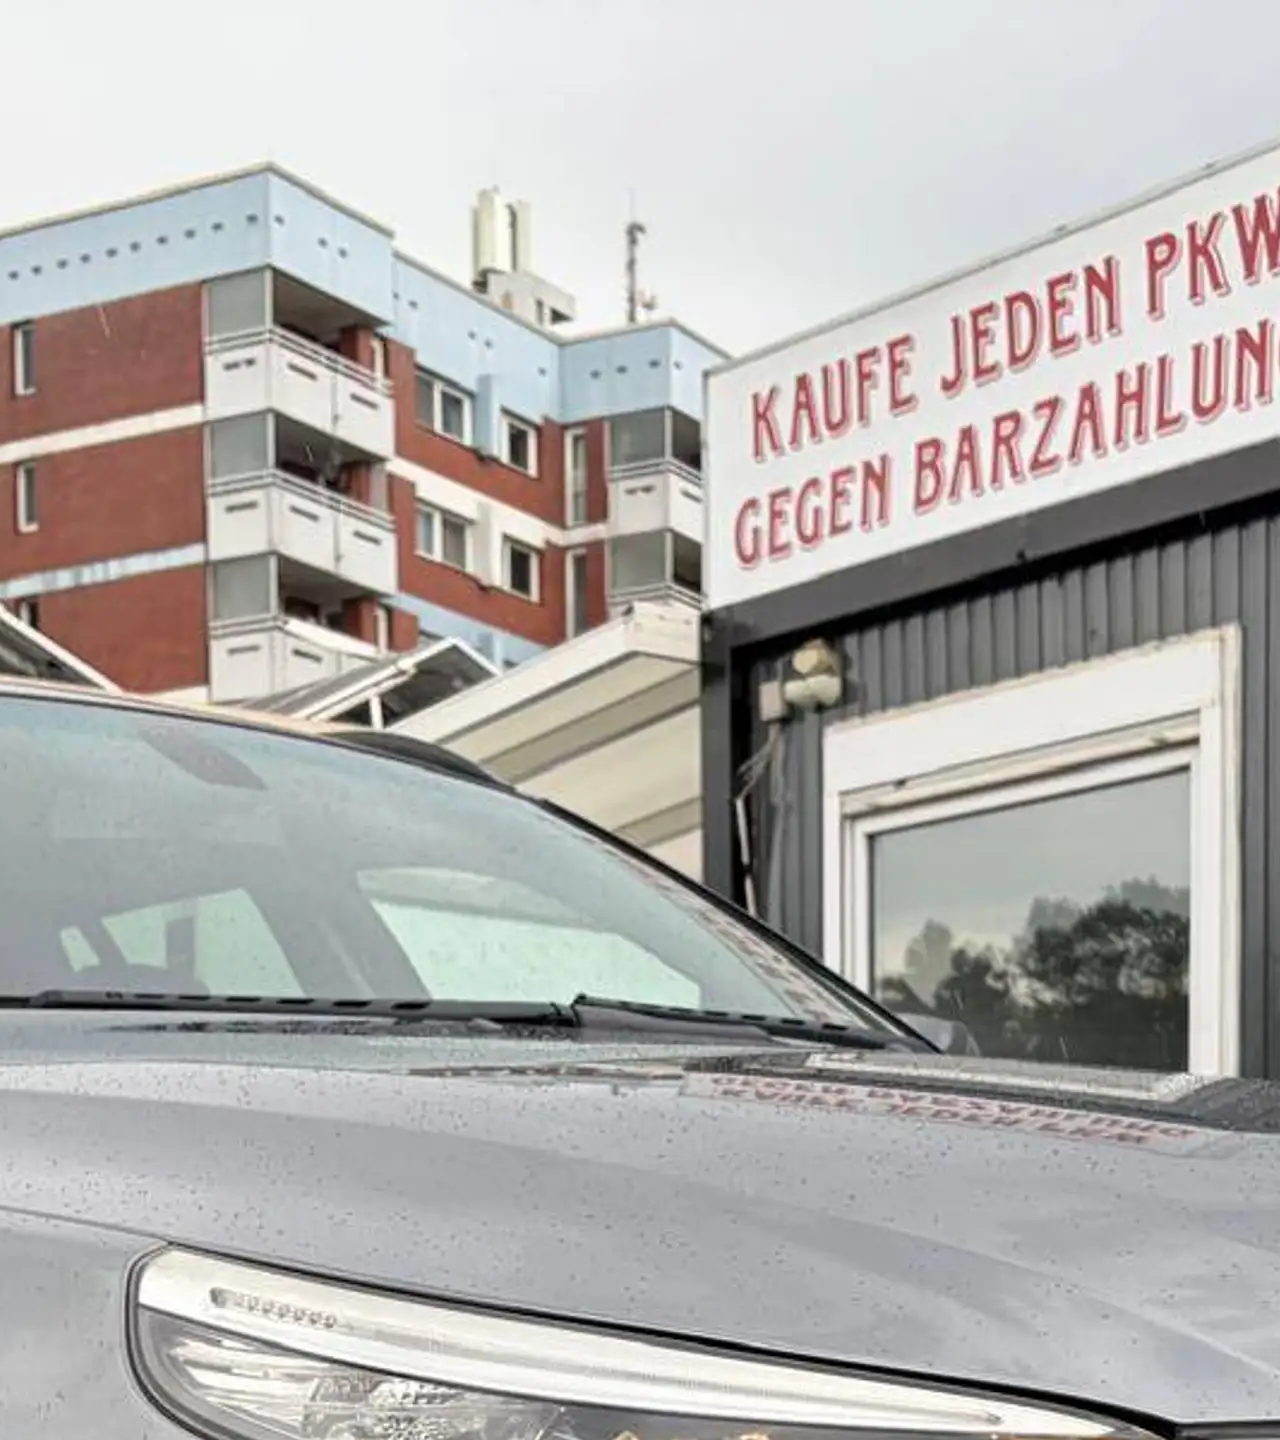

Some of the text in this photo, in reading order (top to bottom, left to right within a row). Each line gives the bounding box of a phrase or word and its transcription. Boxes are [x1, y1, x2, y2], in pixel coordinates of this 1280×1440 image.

[751, 333, 920, 464] KAUFE
[940, 254, 1122, 400] JEDEN
[734, 452, 893, 569] GEGEN
